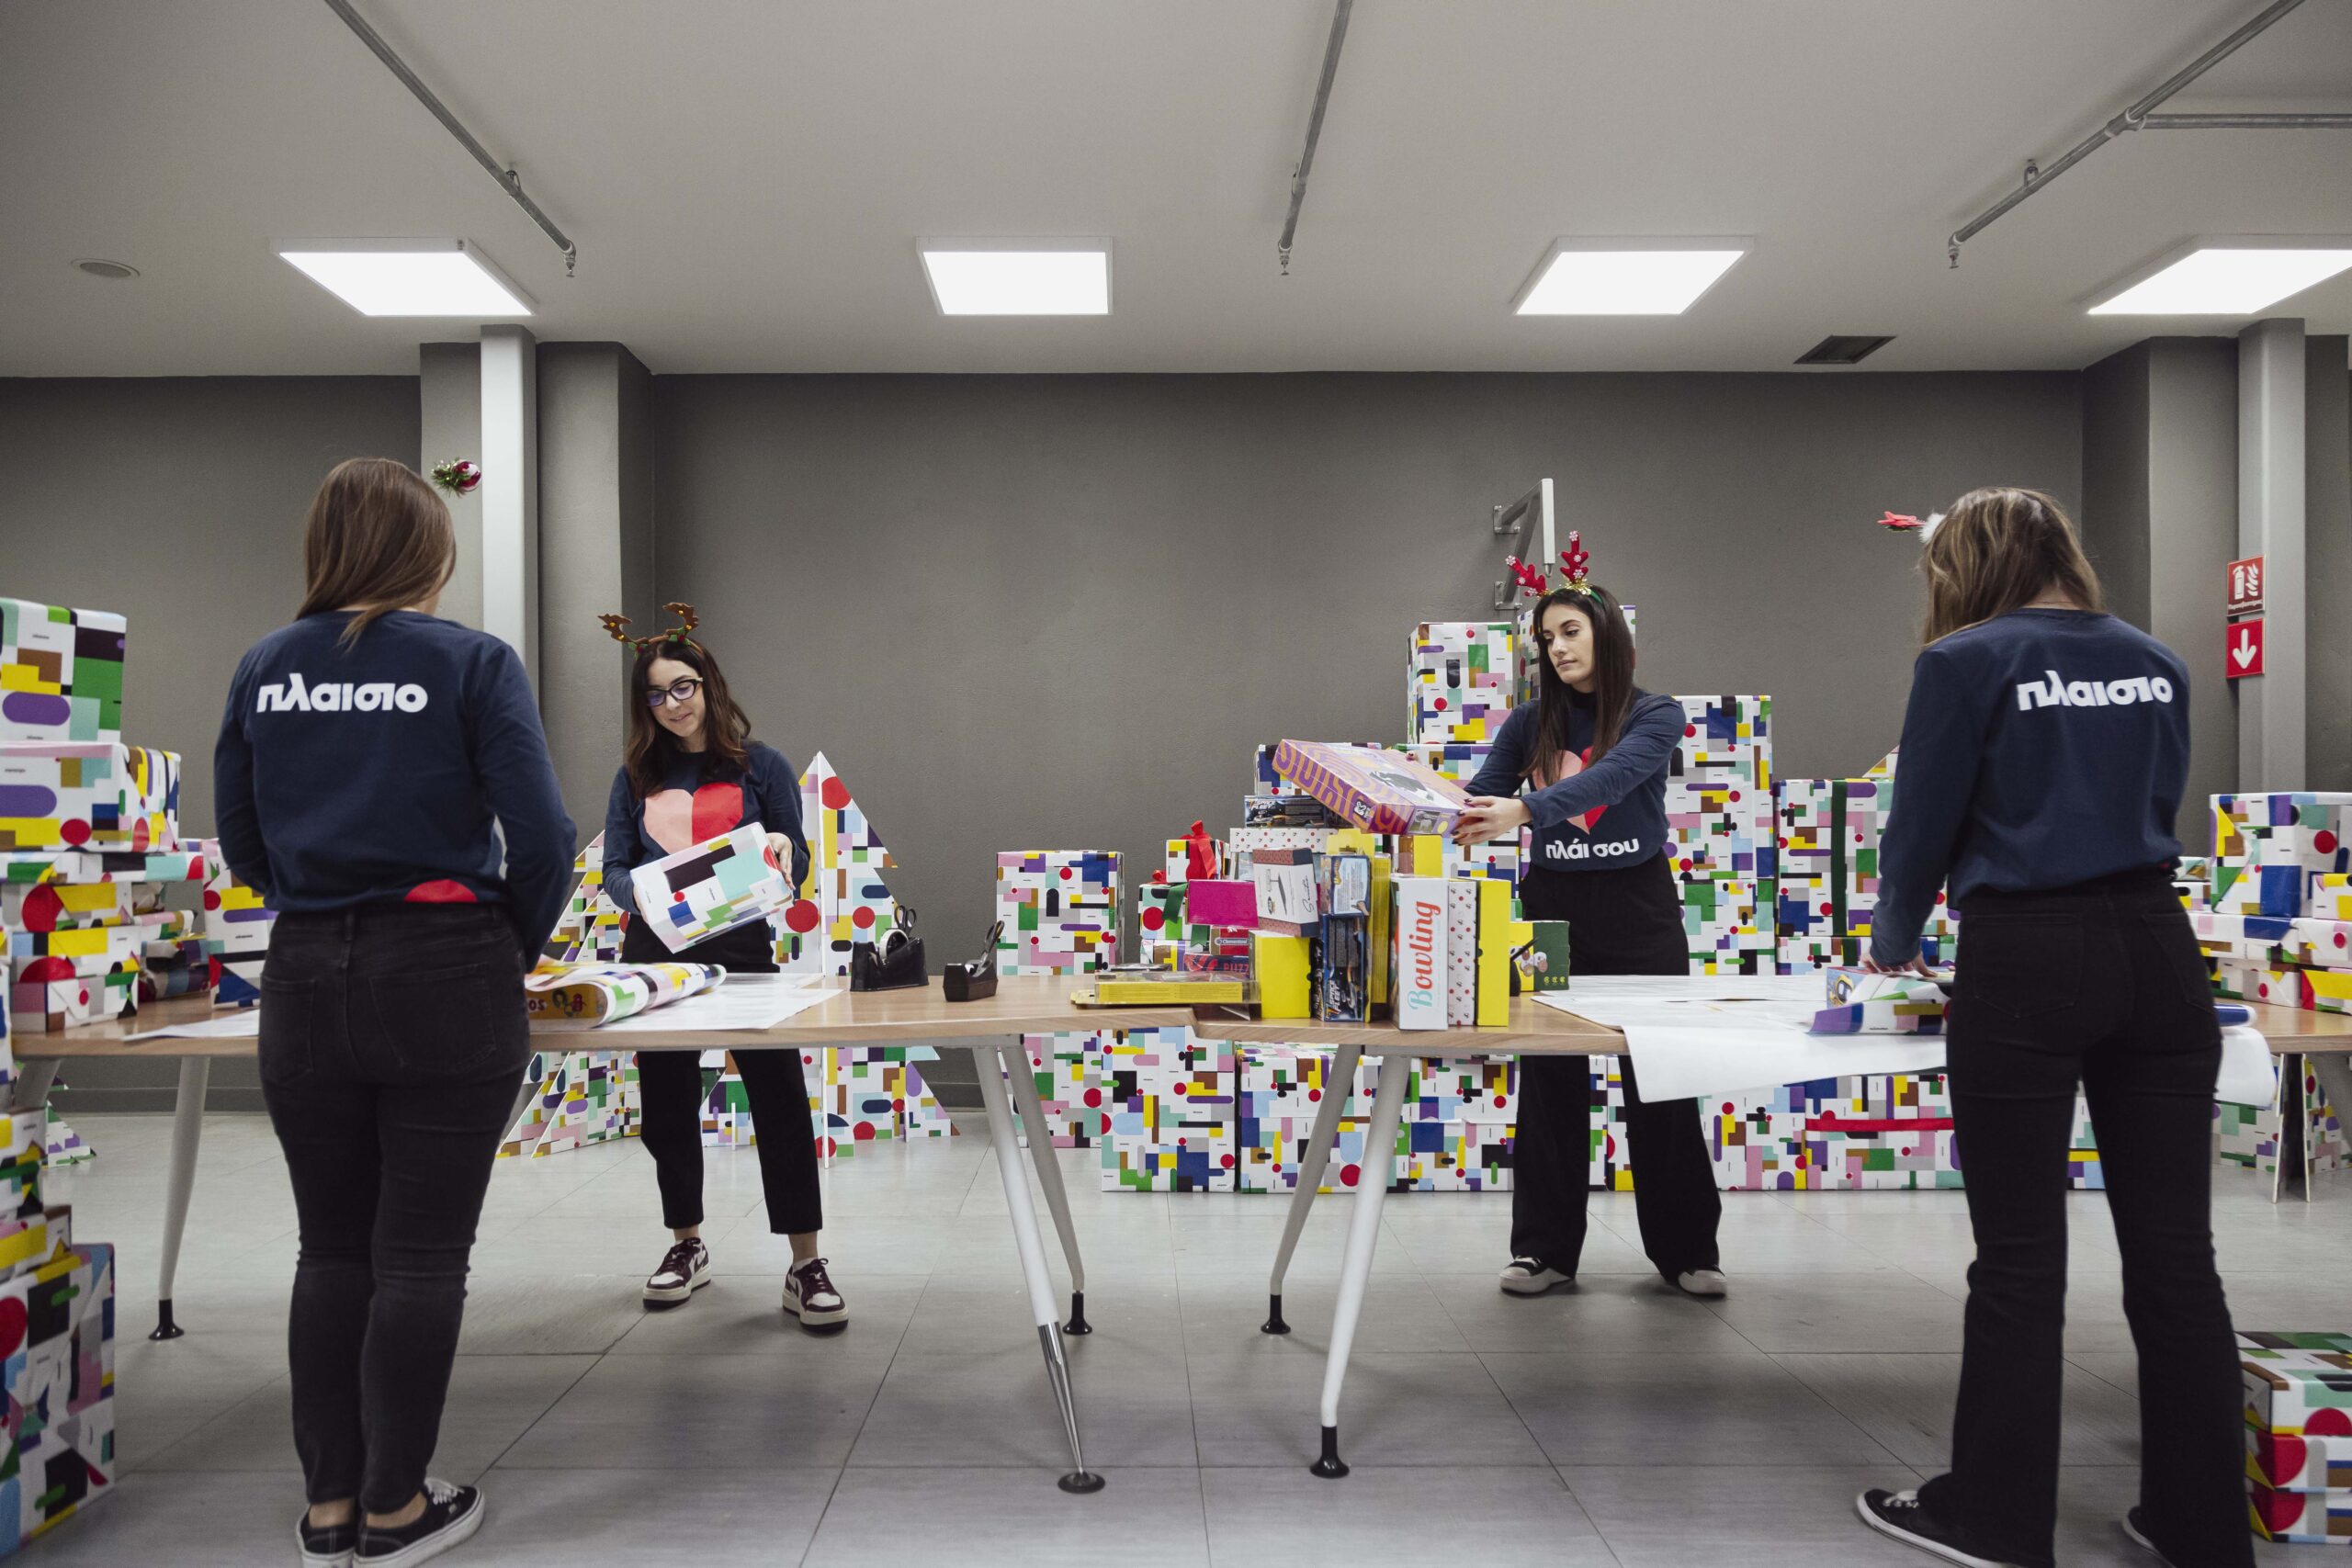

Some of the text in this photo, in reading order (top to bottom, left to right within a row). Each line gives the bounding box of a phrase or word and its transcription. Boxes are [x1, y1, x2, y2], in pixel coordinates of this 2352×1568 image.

[1545, 838, 1640, 860] πλάι σου
[1408, 900, 1442, 1010] Bowling
